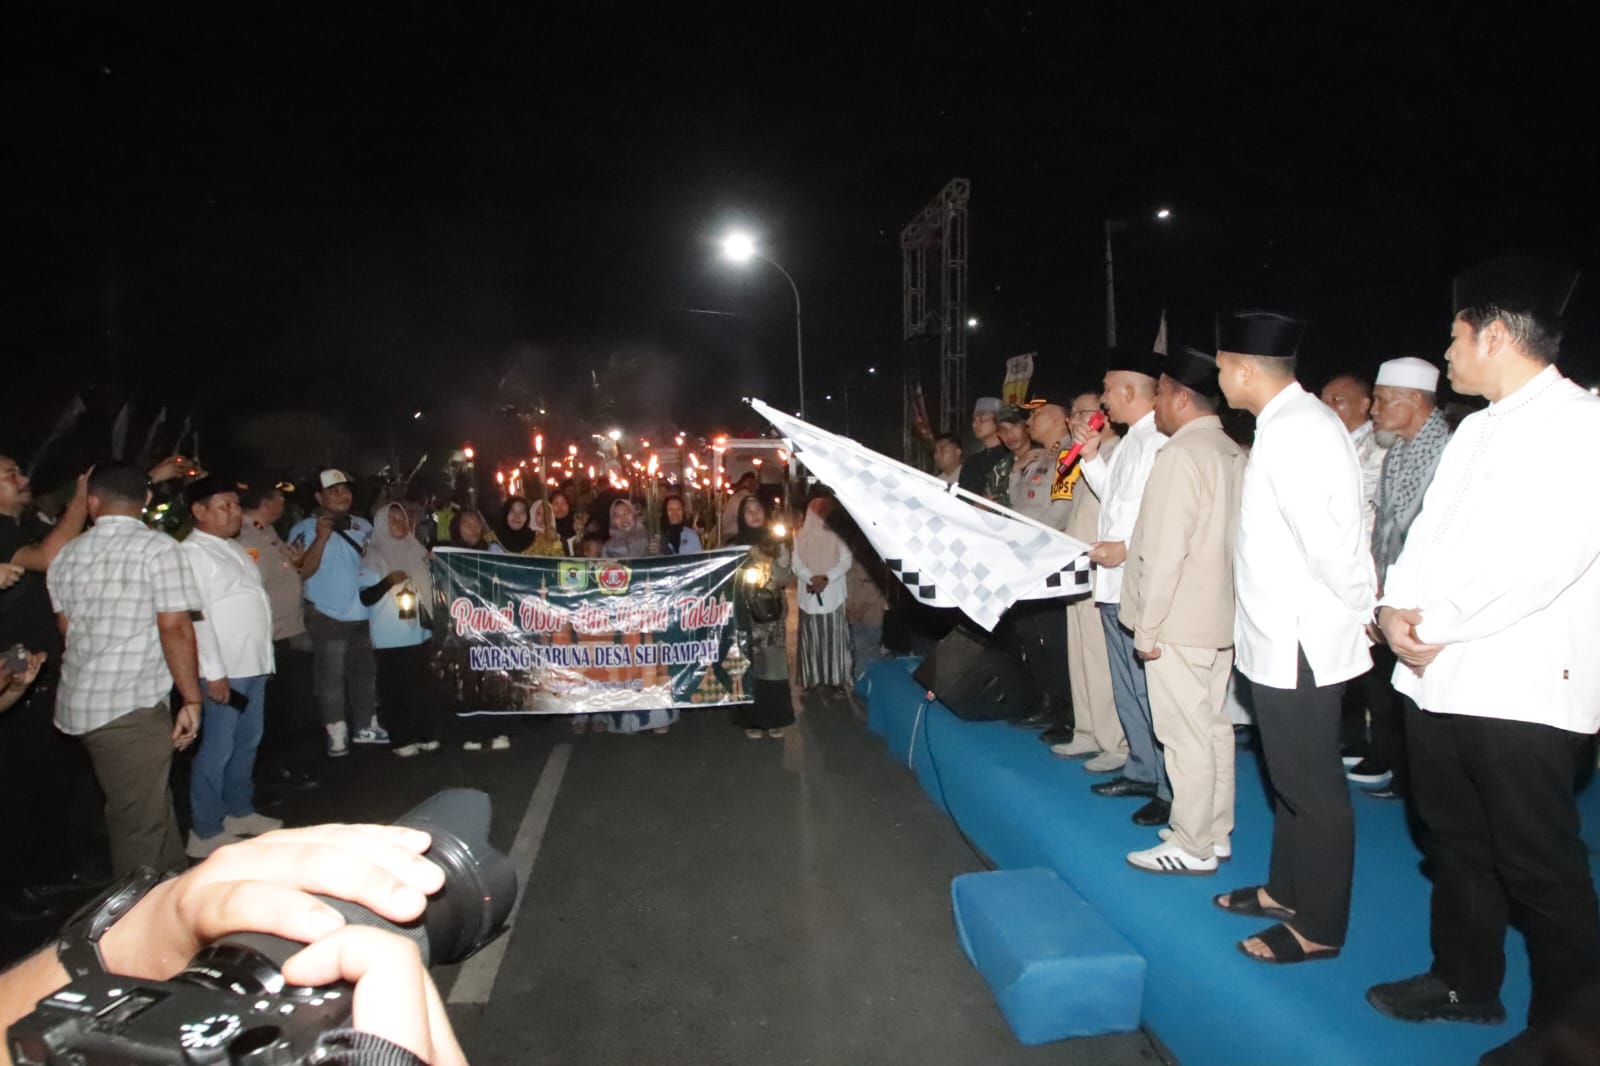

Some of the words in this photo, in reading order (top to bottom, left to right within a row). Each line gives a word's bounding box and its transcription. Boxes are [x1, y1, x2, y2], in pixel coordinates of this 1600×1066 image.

[451, 597, 514, 636] Pawai
[520, 598, 565, 632] Obor
[676, 596, 733, 631] Takbir
[470, 646, 530, 670] KARANG
[533, 646, 590, 668] TARUNA
[595, 645, 632, 667] DESA
[634, 645, 657, 665] SEI
[662, 640, 719, 663] RAMPAH
